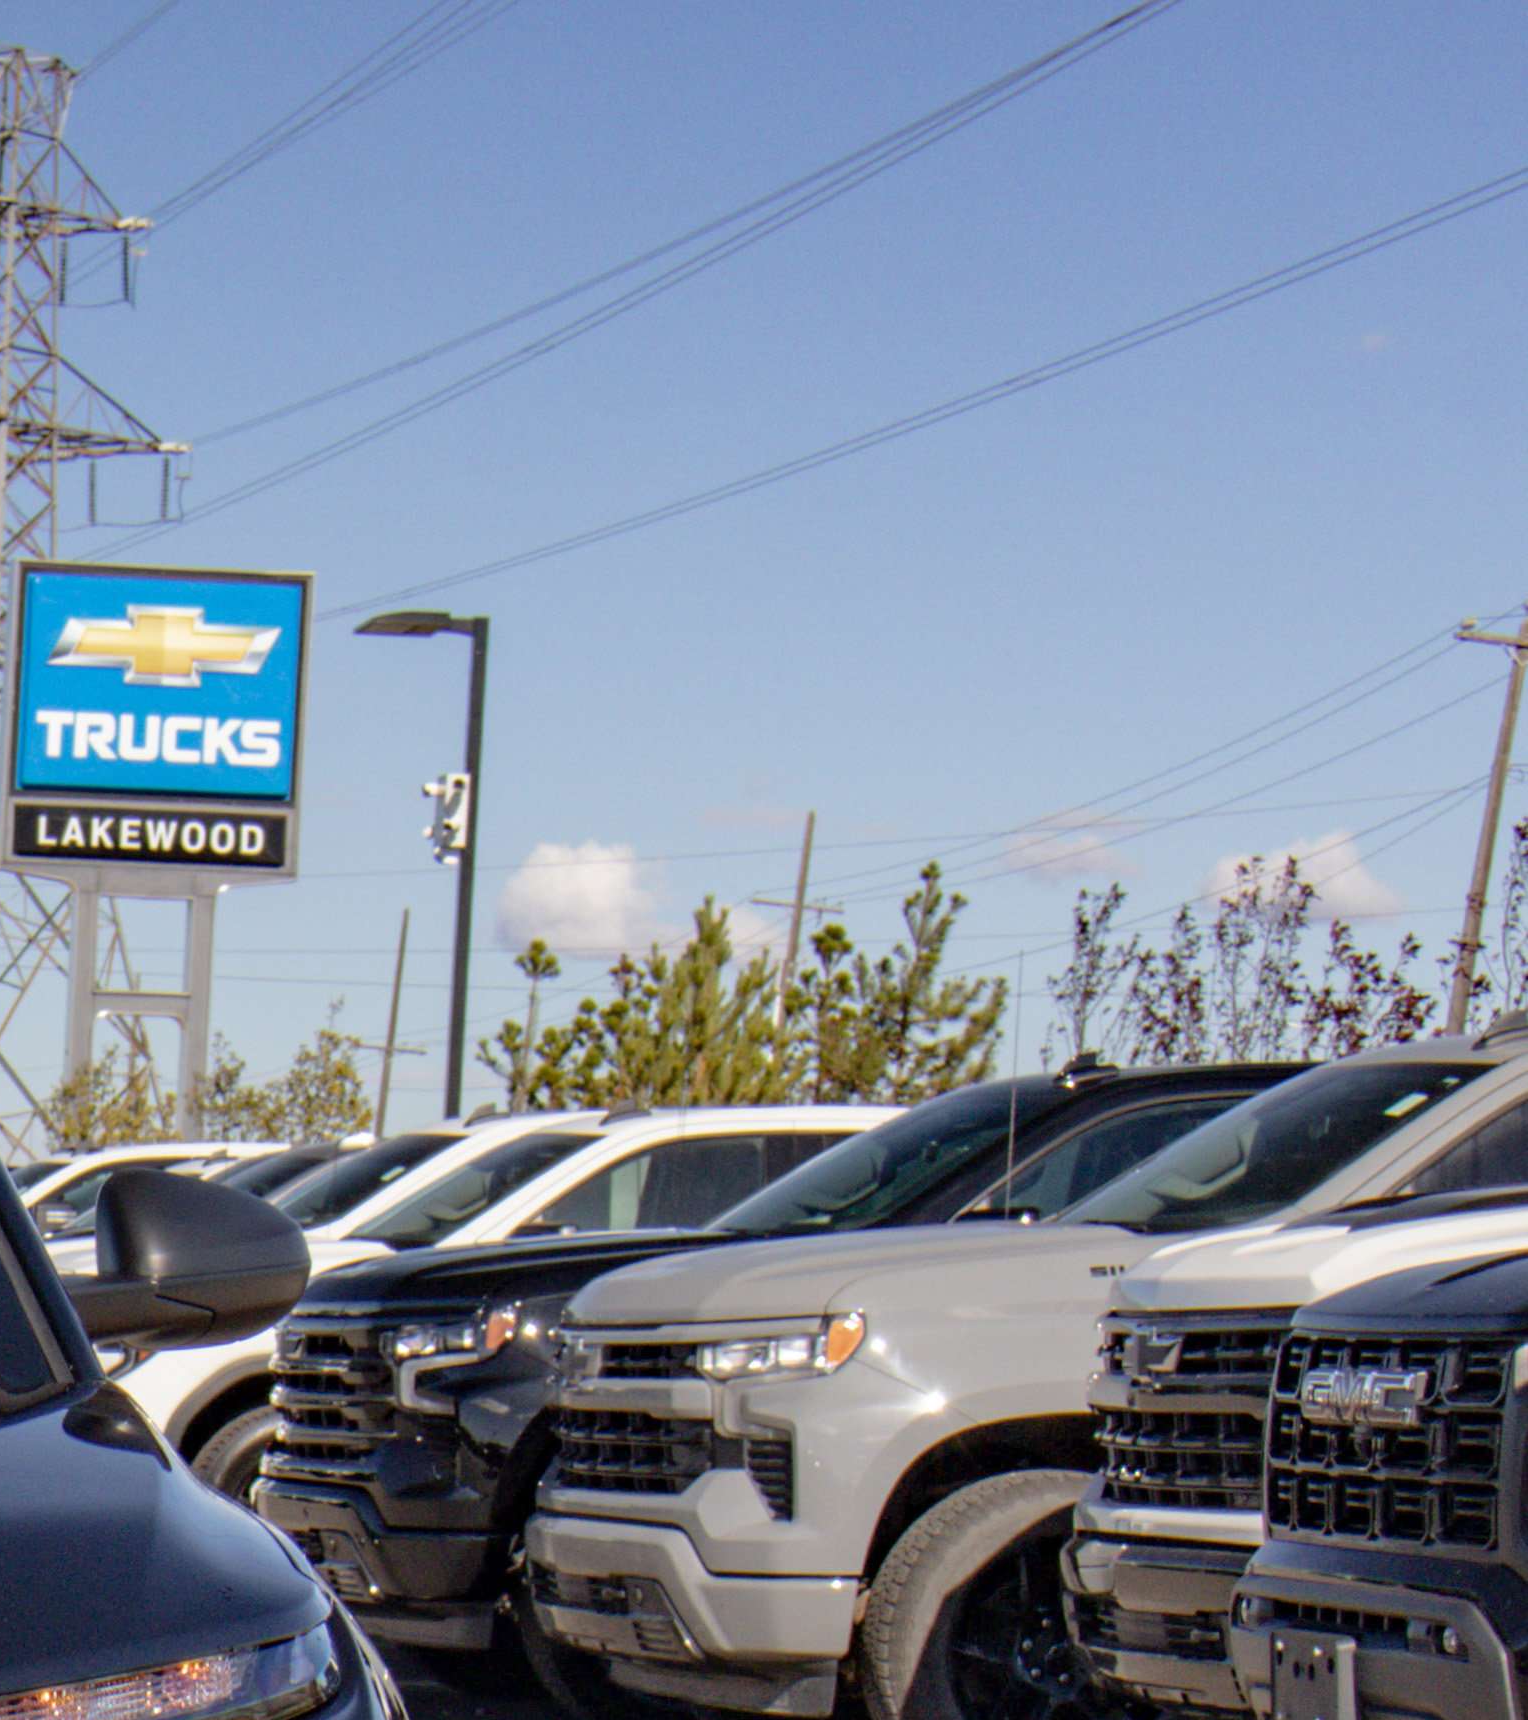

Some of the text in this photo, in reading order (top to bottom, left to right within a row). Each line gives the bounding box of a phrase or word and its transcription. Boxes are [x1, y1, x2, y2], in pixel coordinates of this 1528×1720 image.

[35, 710, 282, 768] TRUCKS
[36, 814, 266, 855] LAKEWOOD
[1302, 1367, 1427, 1425] GMC
